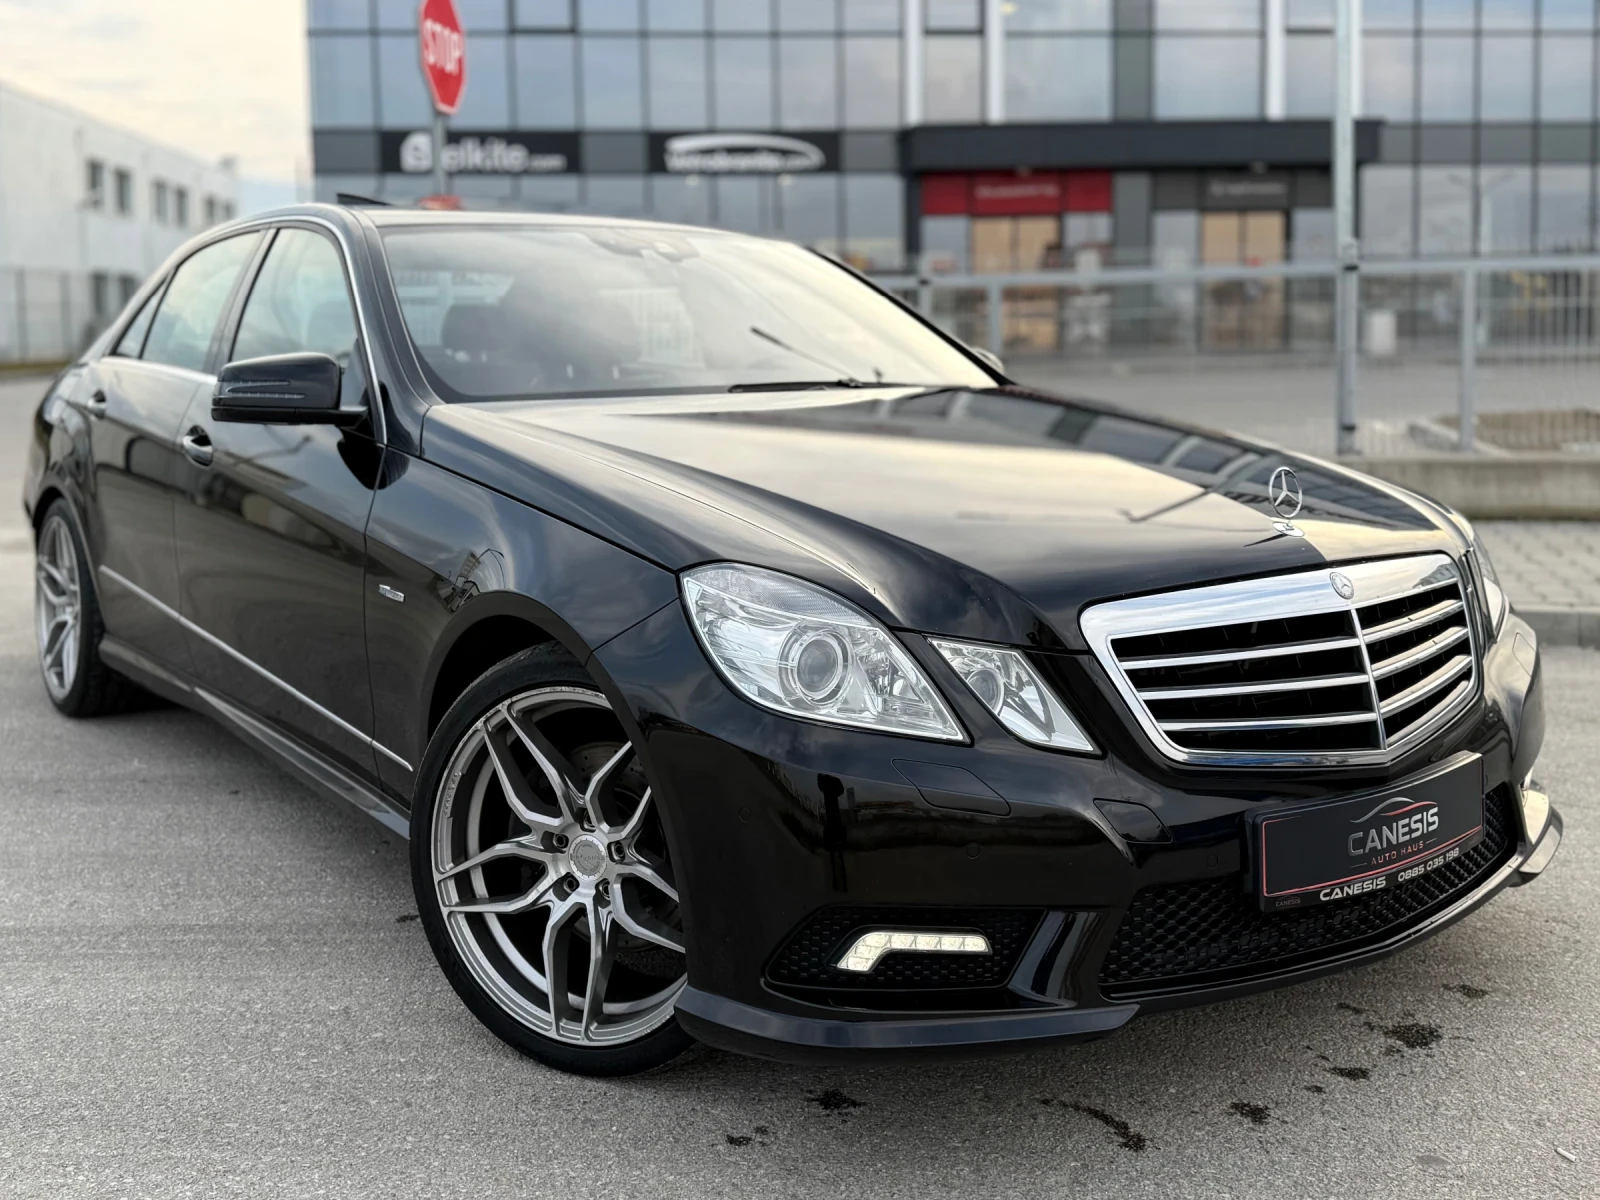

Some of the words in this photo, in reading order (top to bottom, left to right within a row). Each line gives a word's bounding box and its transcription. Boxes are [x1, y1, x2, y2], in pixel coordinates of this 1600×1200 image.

[424, 18, 462, 76] STOP
[1347, 806, 1439, 857] CANESIS
[1371, 851, 1397, 866] AUTO
[1400, 840, 1424, 856] HAUS
[1320, 876, 1386, 901] CANESIS
[1397, 864, 1425, 882] 0885
[1426, 855, 1444, 871] 035
[1445, 847, 1460, 861] 198
[1275, 898, 1301, 907] CANESIS
